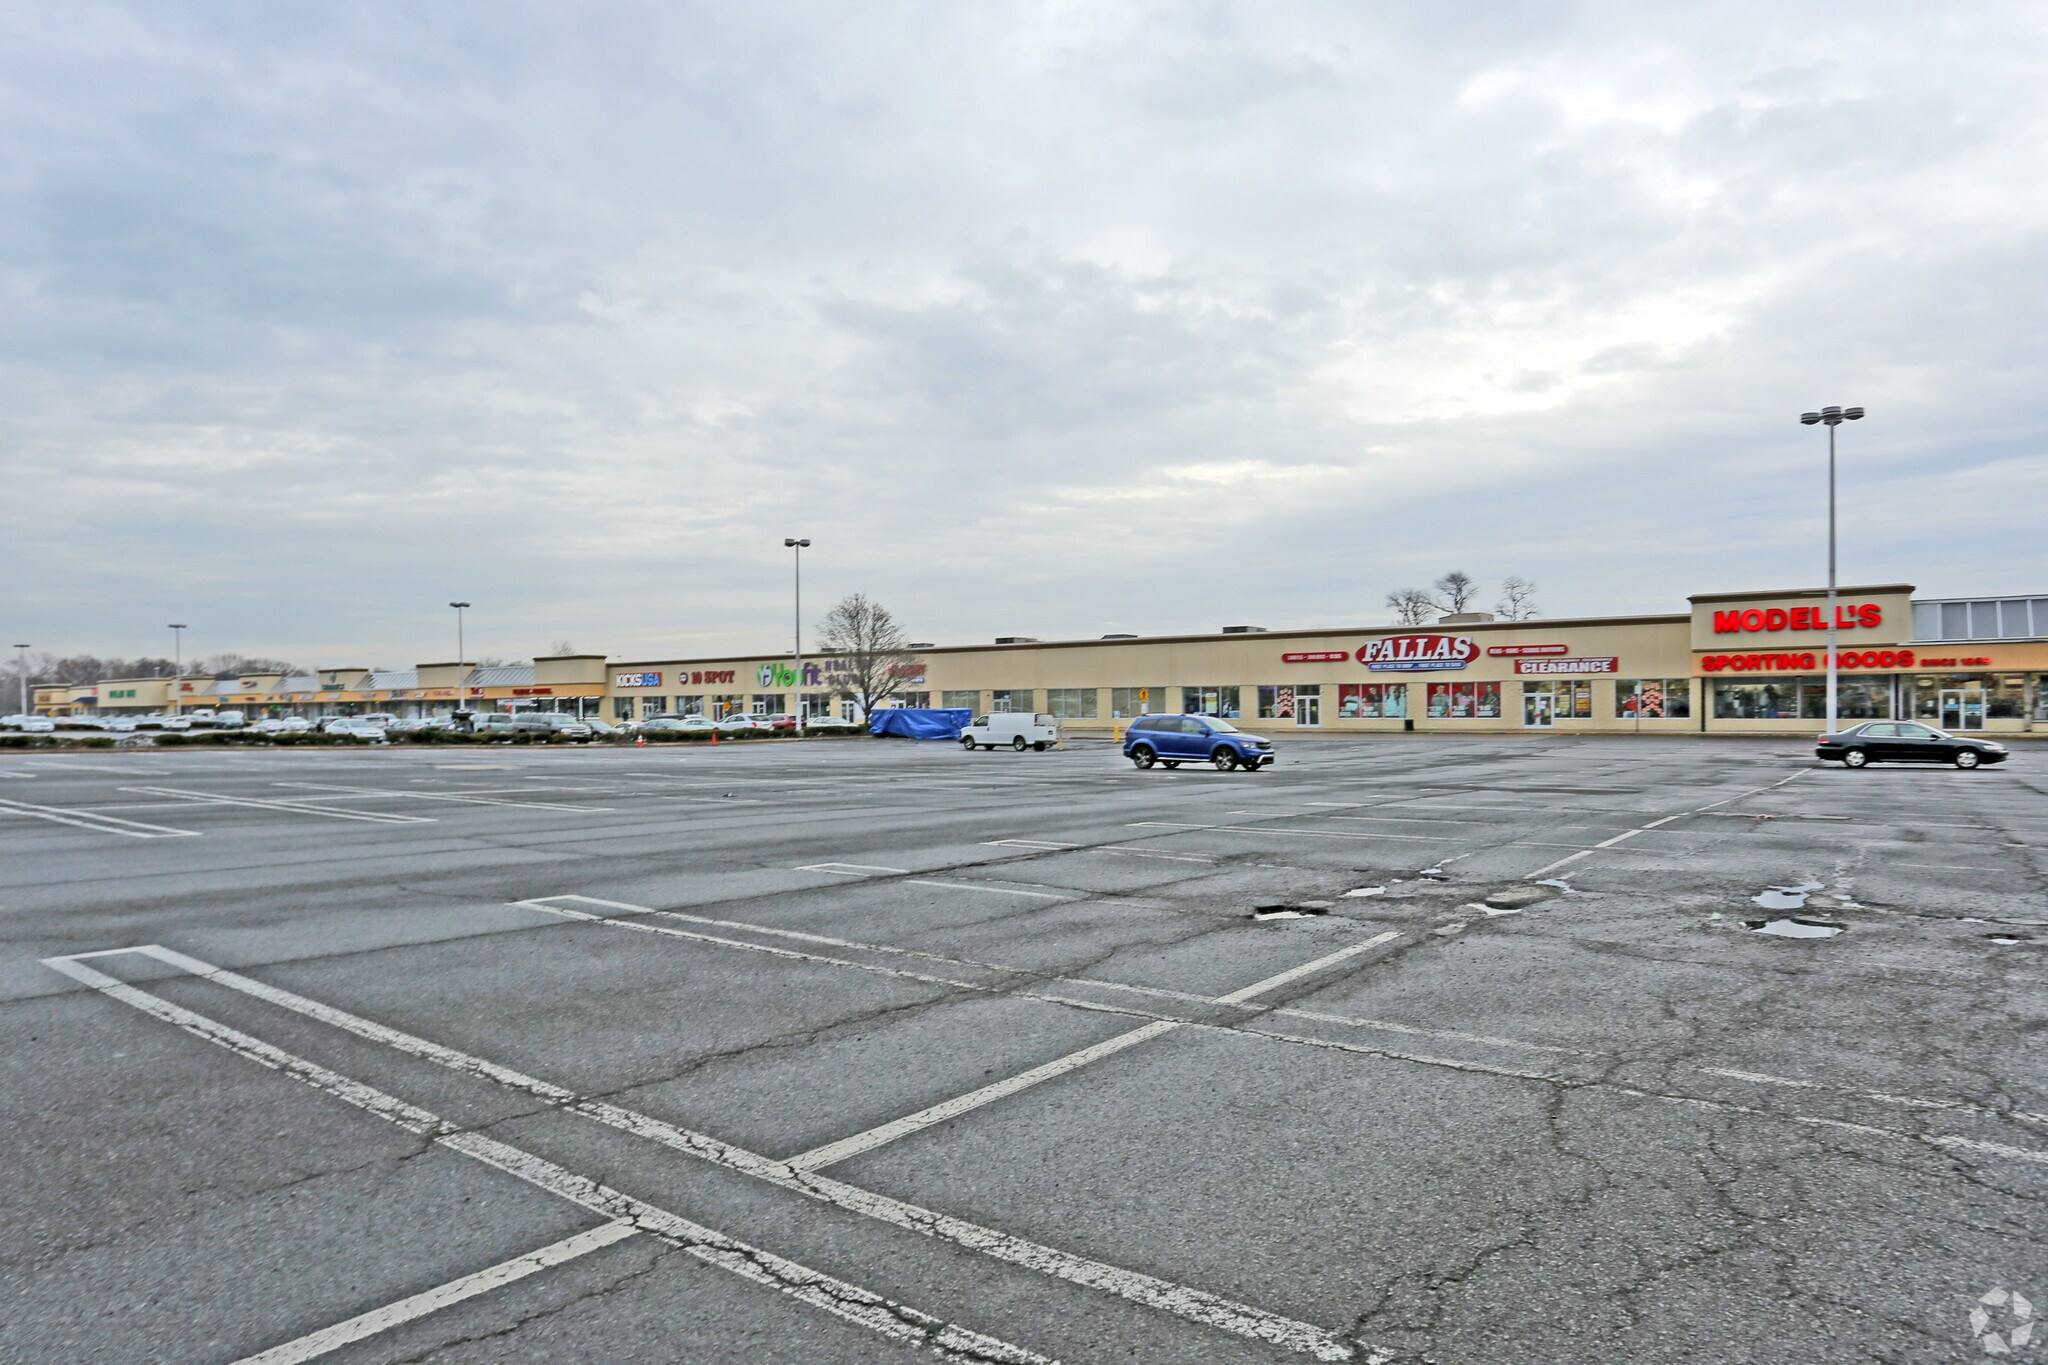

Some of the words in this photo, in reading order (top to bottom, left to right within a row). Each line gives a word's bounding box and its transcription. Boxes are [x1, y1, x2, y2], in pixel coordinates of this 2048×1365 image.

[1714, 604, 1882, 633] MODELL'S
[1362, 636, 1472, 662] FALLAS
[1520, 661, 1612, 674] CLEARANCE
[1702, 653, 1816, 672] SPORTING
[704, 670, 735, 684] SPOT
